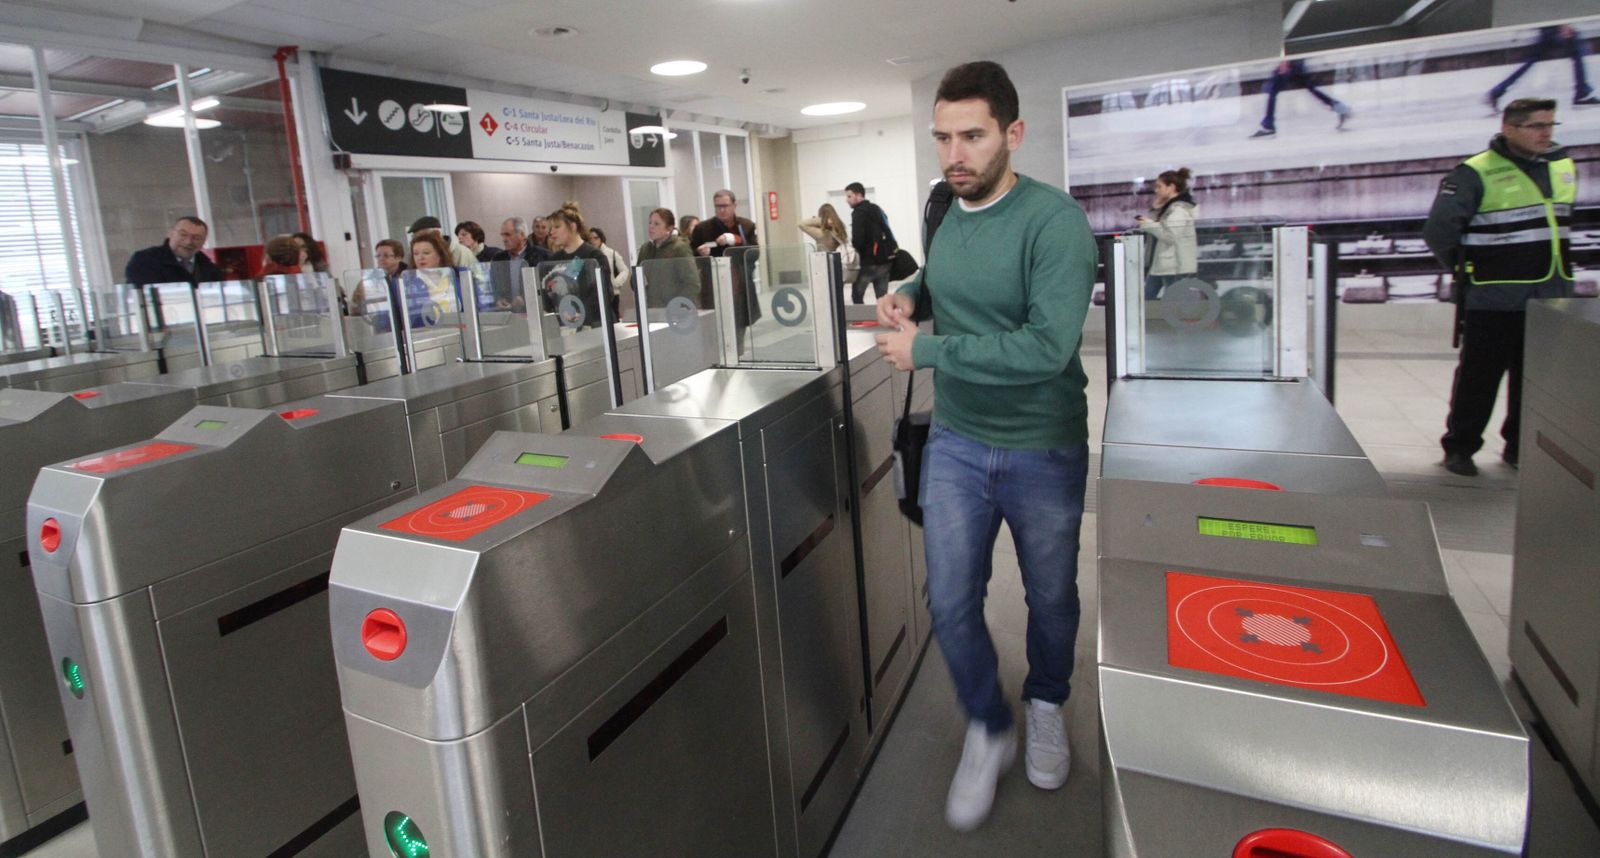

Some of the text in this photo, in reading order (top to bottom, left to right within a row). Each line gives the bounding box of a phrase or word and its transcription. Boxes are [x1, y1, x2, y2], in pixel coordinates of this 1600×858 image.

[502, 107, 517, 118] C-1
[519, 109, 540, 120] Santa
[485, 118, 494, 132] 1
[504, 121, 548, 134] C-4 Circular
[506, 136, 520, 146] C-5
[521, 137, 543, 148] Santa
